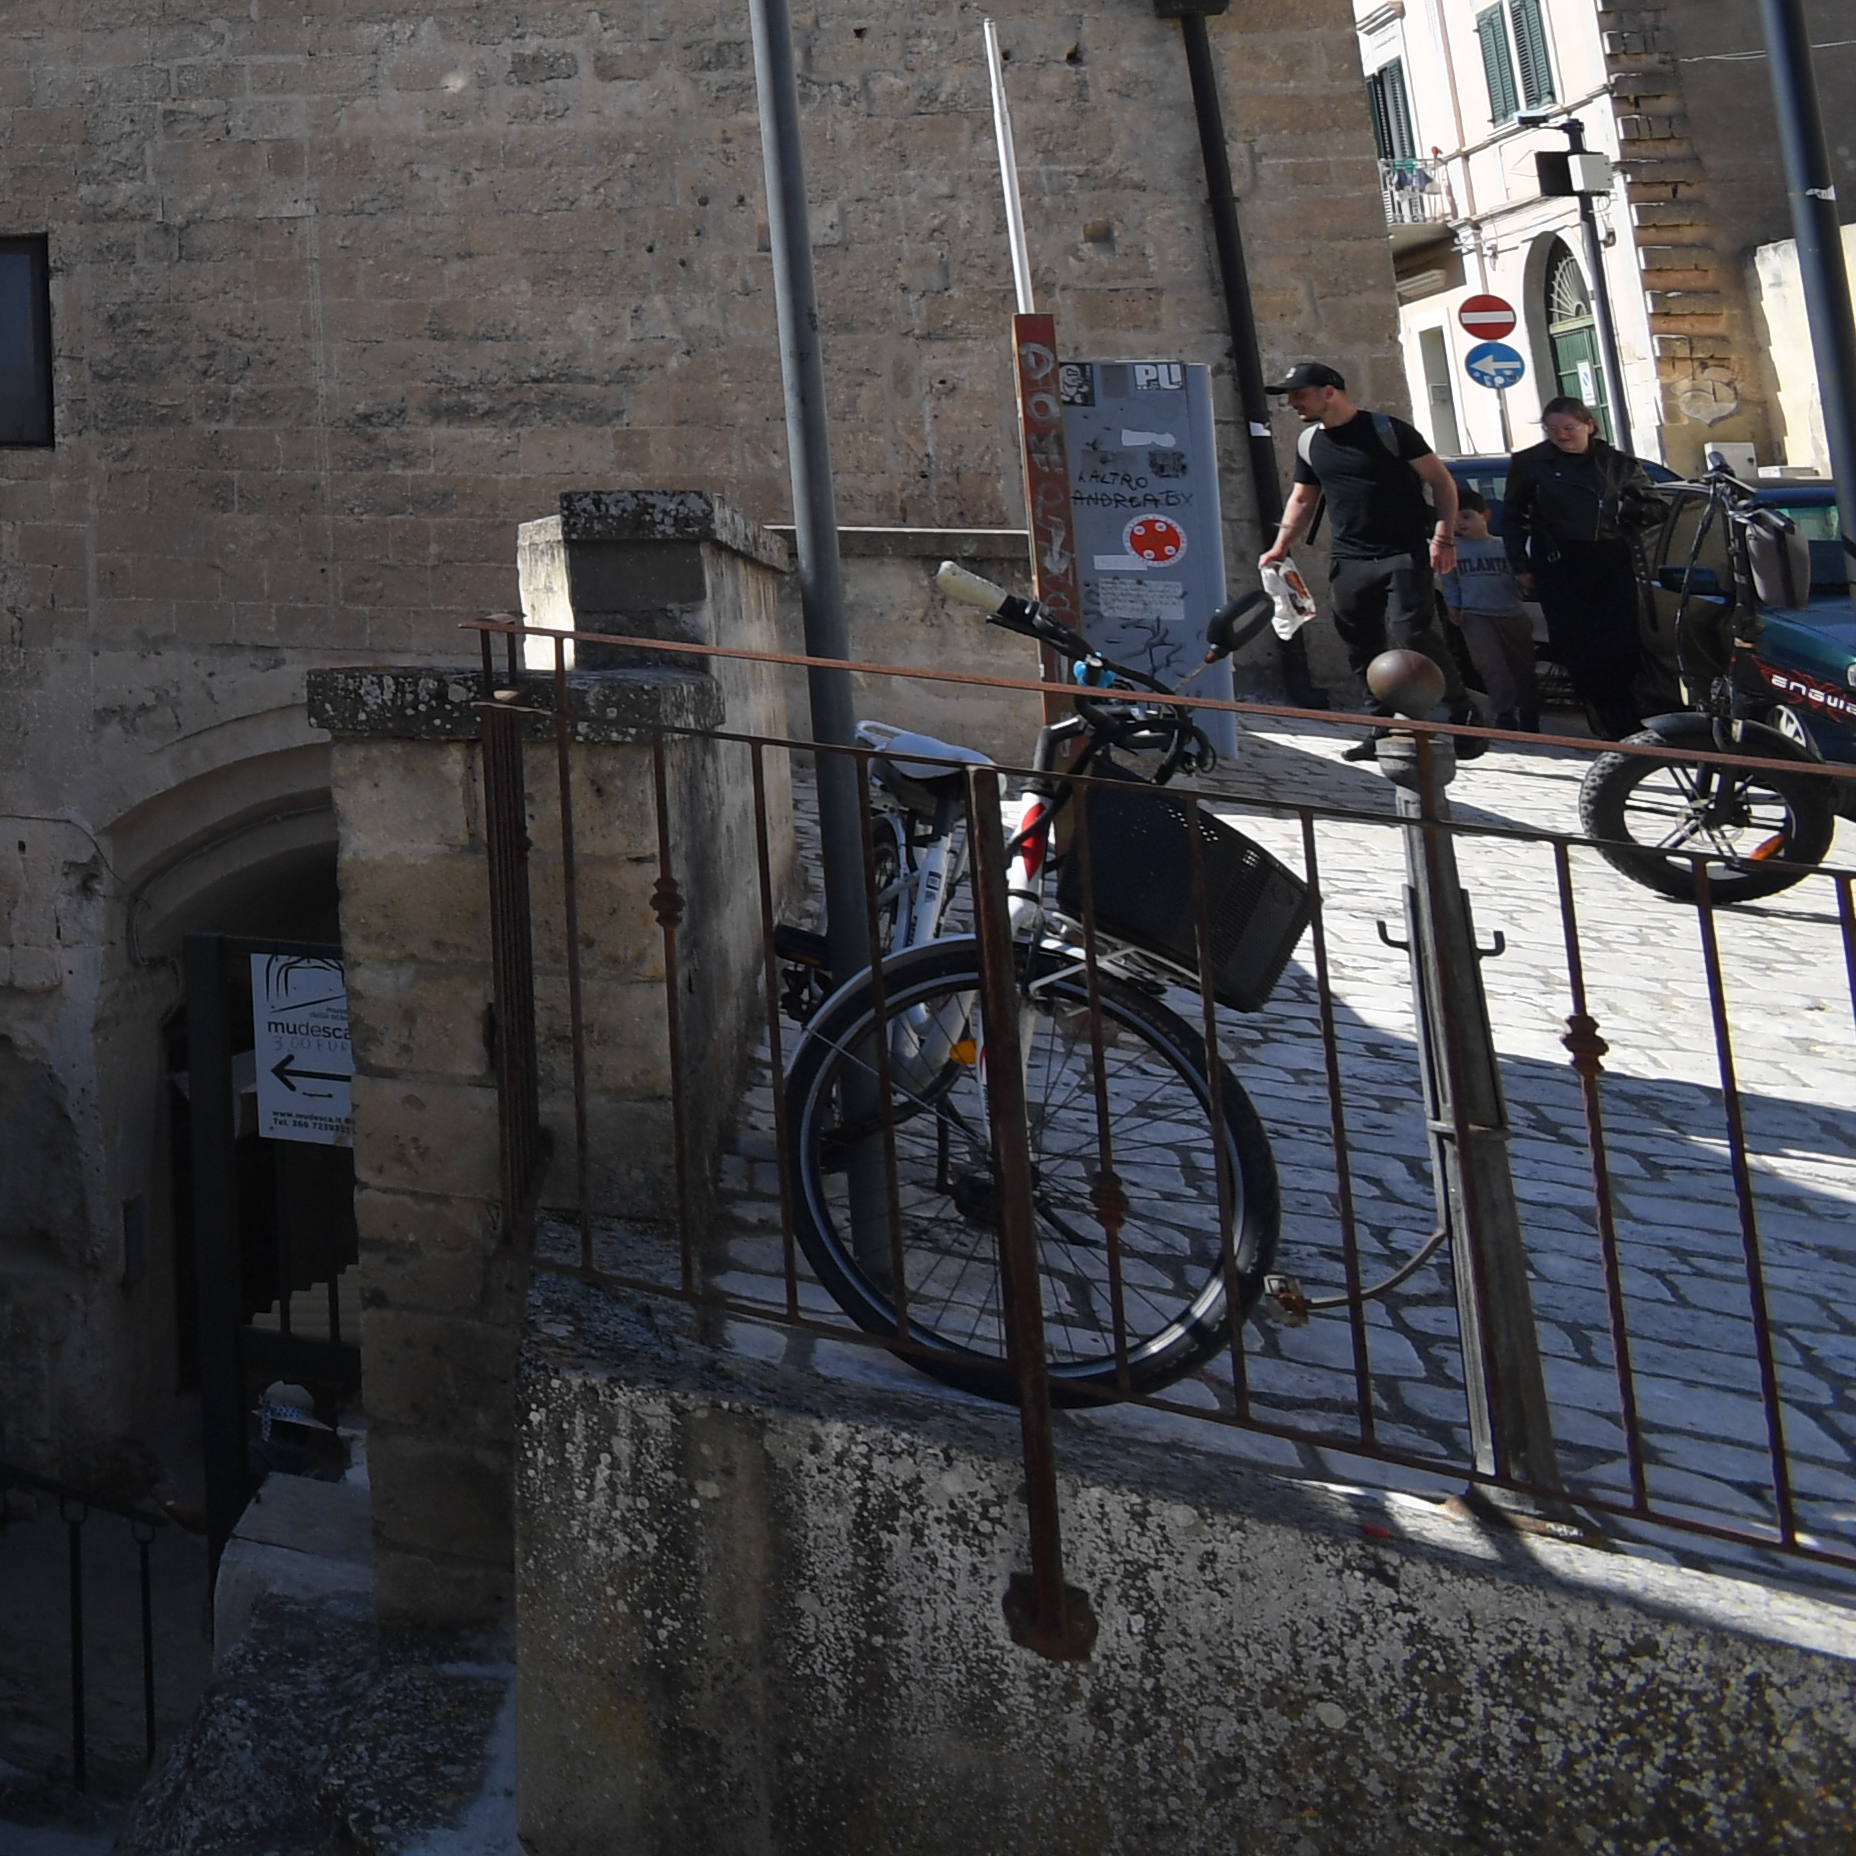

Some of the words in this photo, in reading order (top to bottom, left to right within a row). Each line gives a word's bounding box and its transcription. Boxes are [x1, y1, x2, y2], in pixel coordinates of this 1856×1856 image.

[268, 1021, 351, 1040] mudesca
[317, 1039, 349, 1052] EUR
[274, 1118, 289, 1126] Tel.
